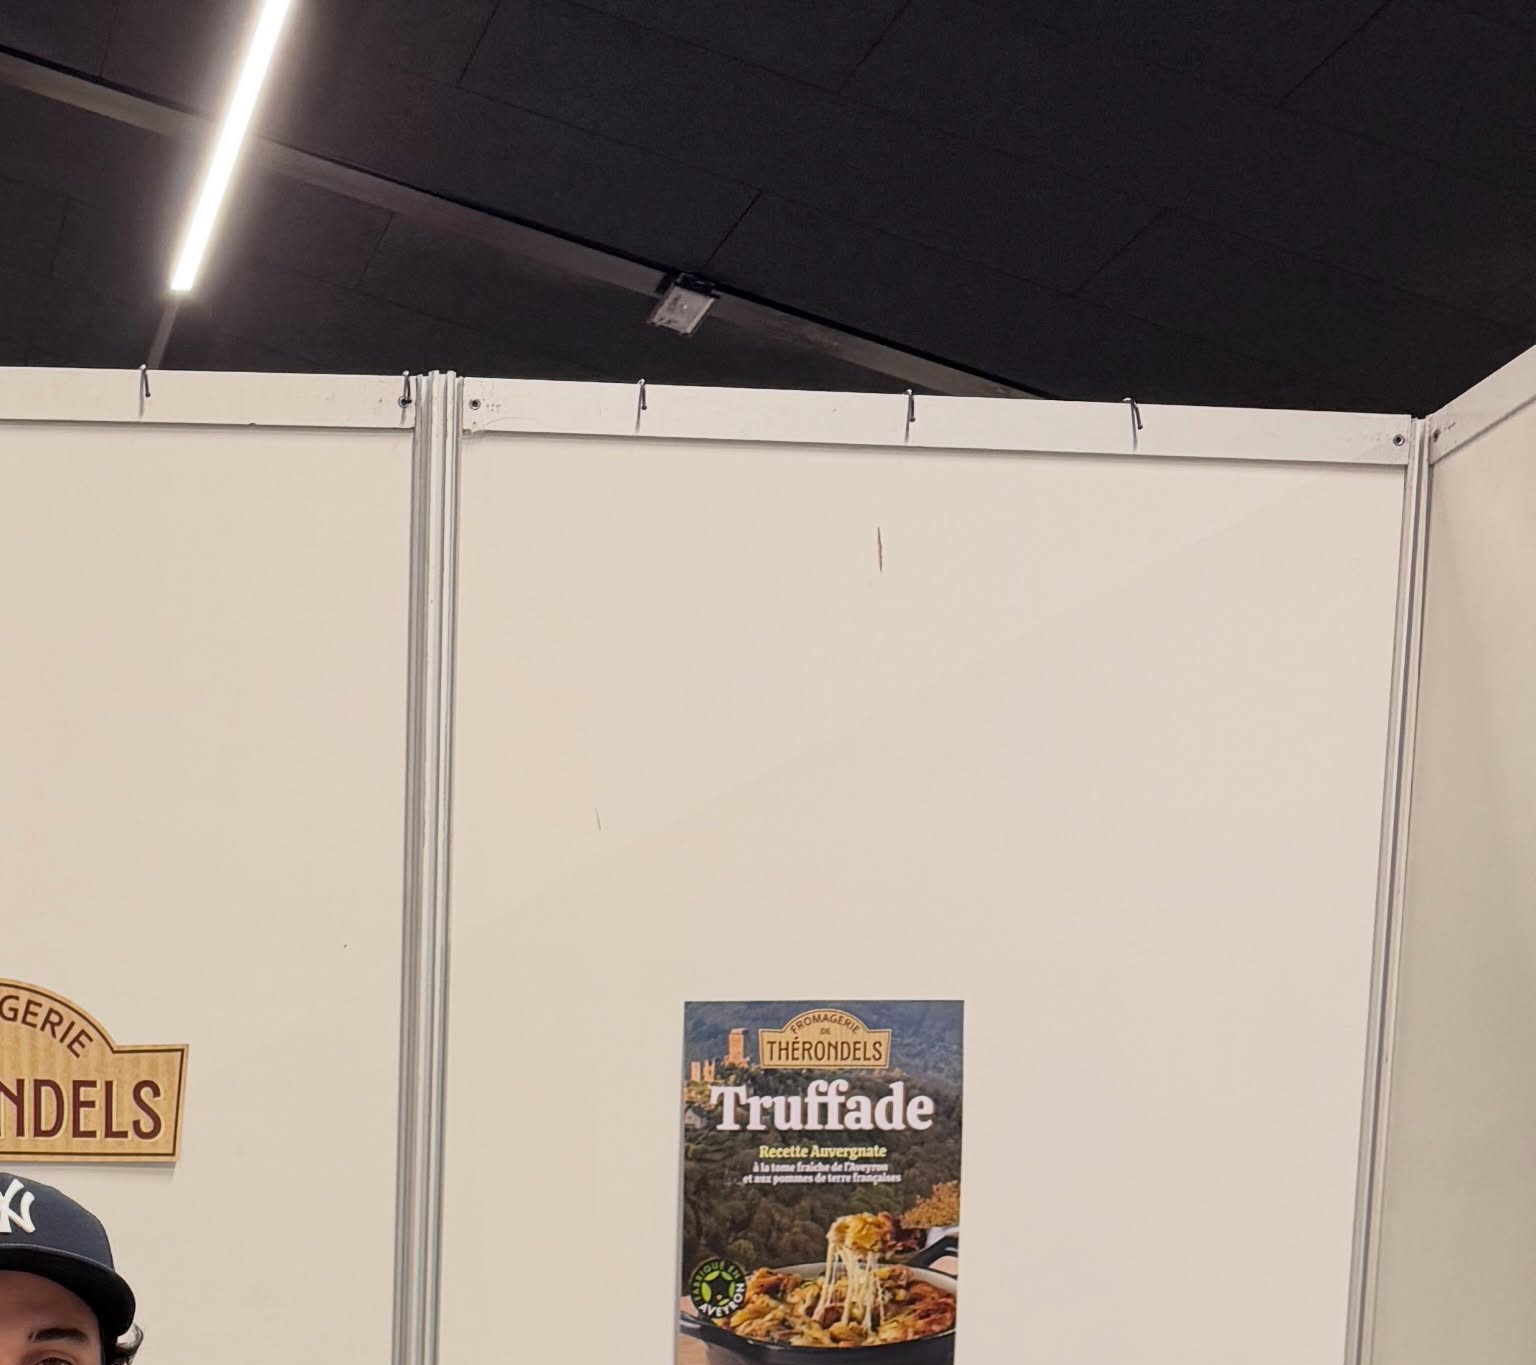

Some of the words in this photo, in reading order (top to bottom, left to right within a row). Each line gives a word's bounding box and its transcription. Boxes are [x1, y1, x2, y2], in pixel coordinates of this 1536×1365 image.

[790, 1014, 860, 1036] FROMAGERIE
[819, 1028, 831, 1036] DE
[767, 1037, 882, 1061] THÉRONDELS
[709, 1079, 935, 1131] Truffade
[759, 1145, 808, 1158] Recette
[811, 1145, 887, 1160] Auvergnate
[698, 1283, 745, 1317] AVEYRON
